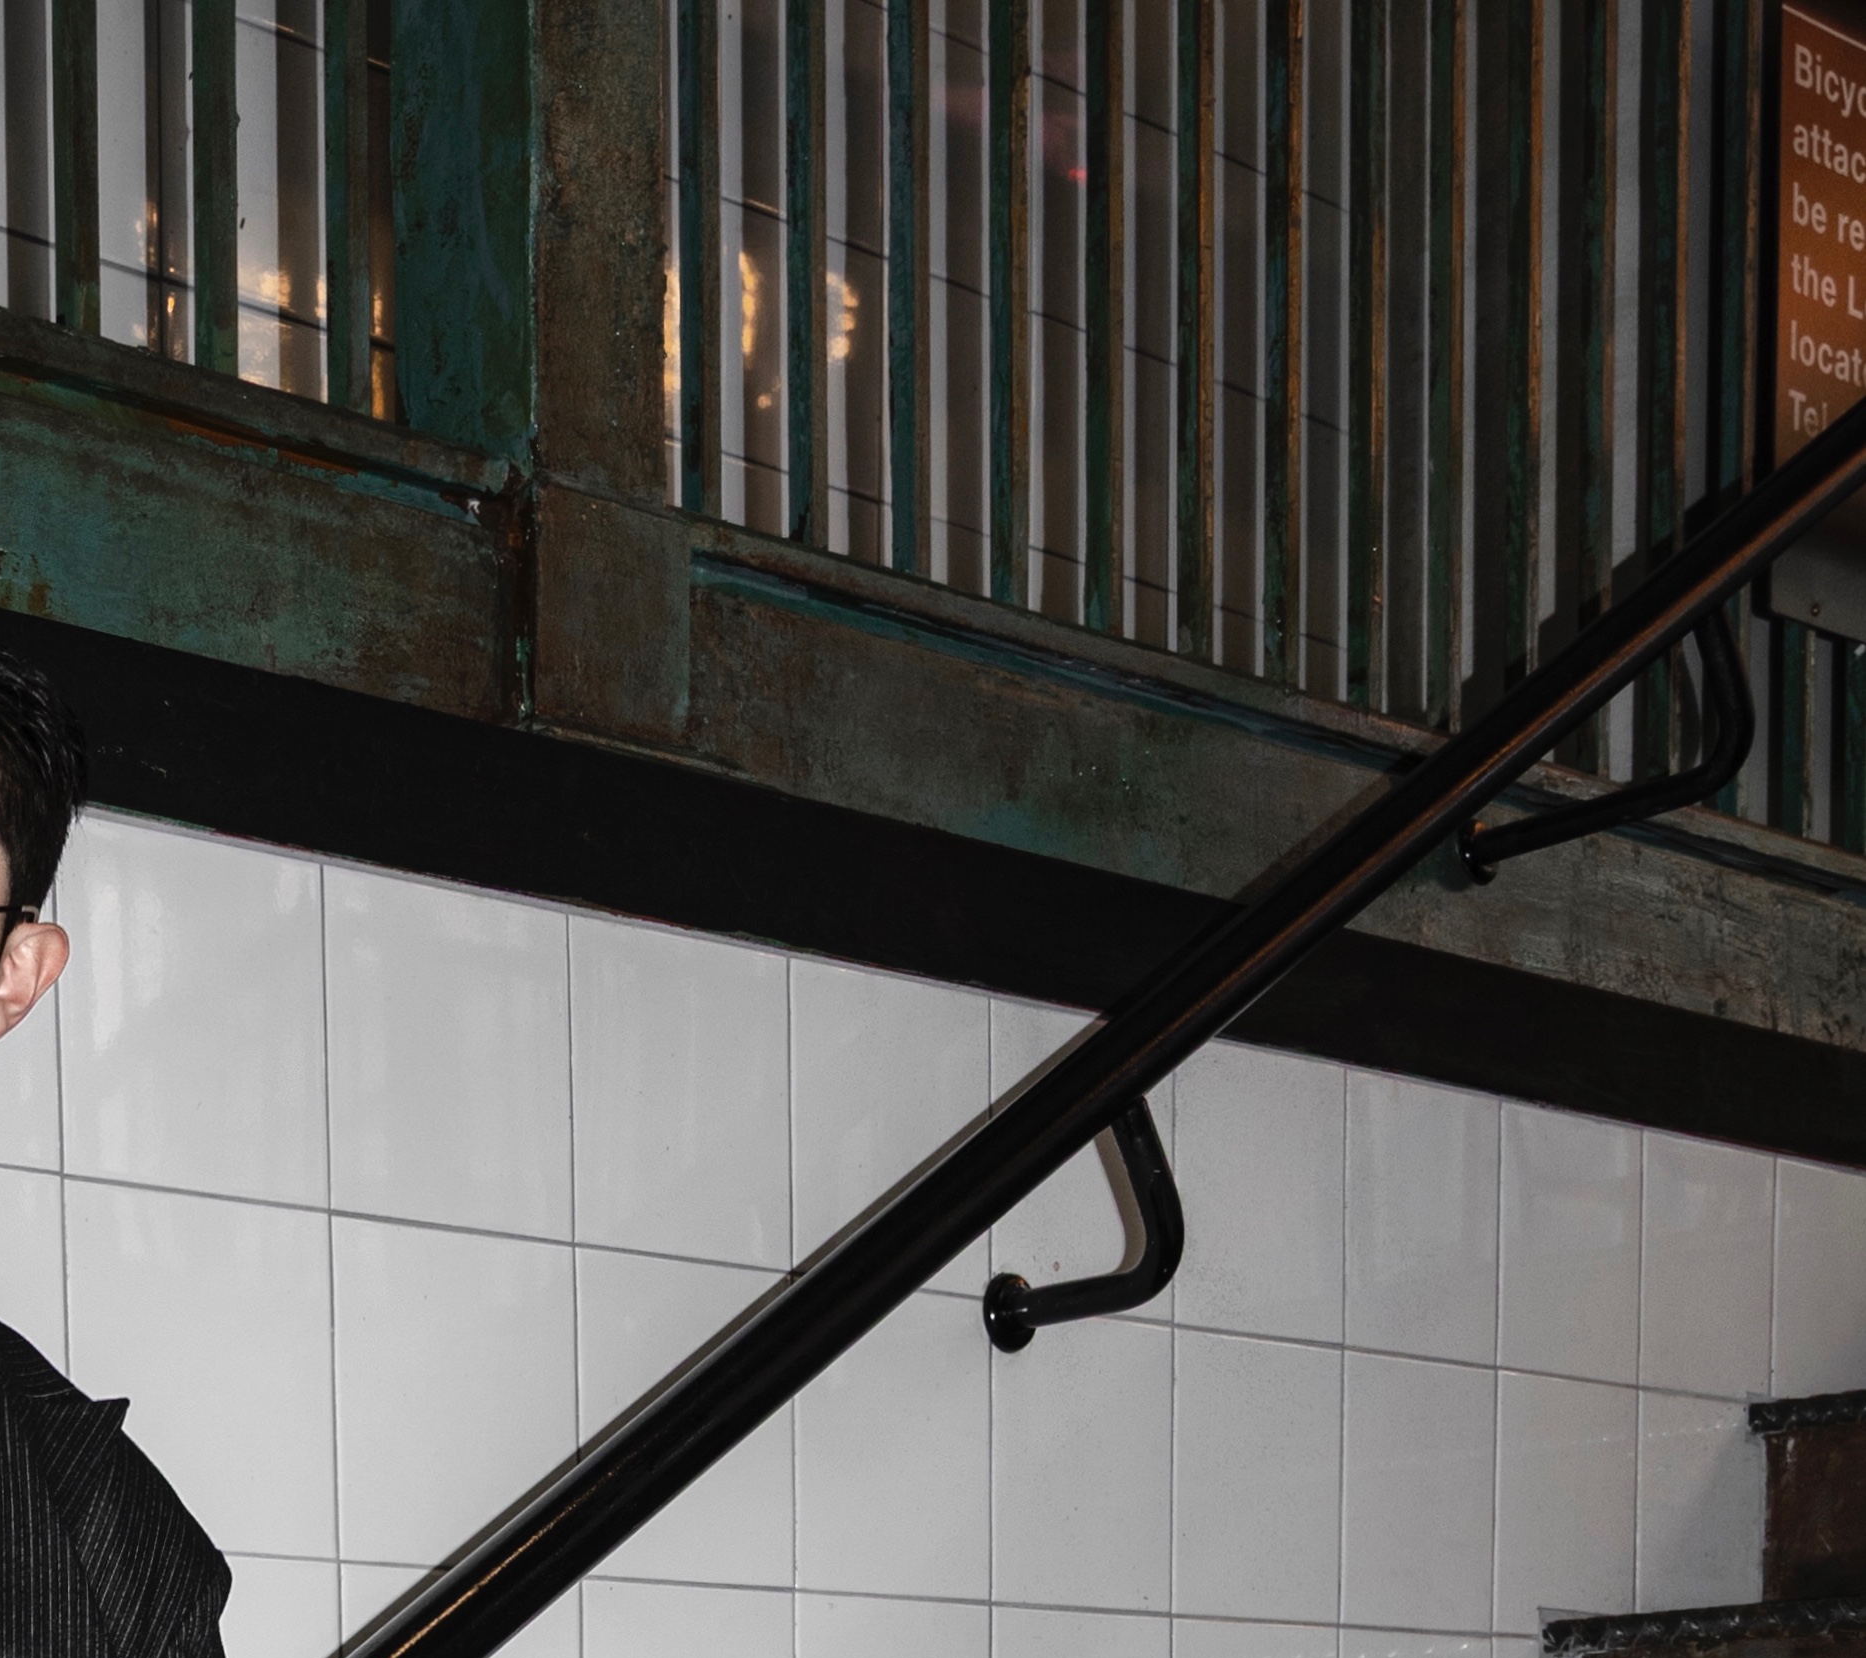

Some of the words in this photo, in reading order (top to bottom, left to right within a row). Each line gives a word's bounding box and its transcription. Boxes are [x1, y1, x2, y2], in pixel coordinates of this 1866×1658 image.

[1793, 123, 1866, 184] attac
[1792, 181, 1827, 235] be
[1837, 213, 1866, 251] re
[1790, 253, 1837, 307] the
[1847, 274, 1866, 320] L
[1790, 319, 1866, 388] locat
